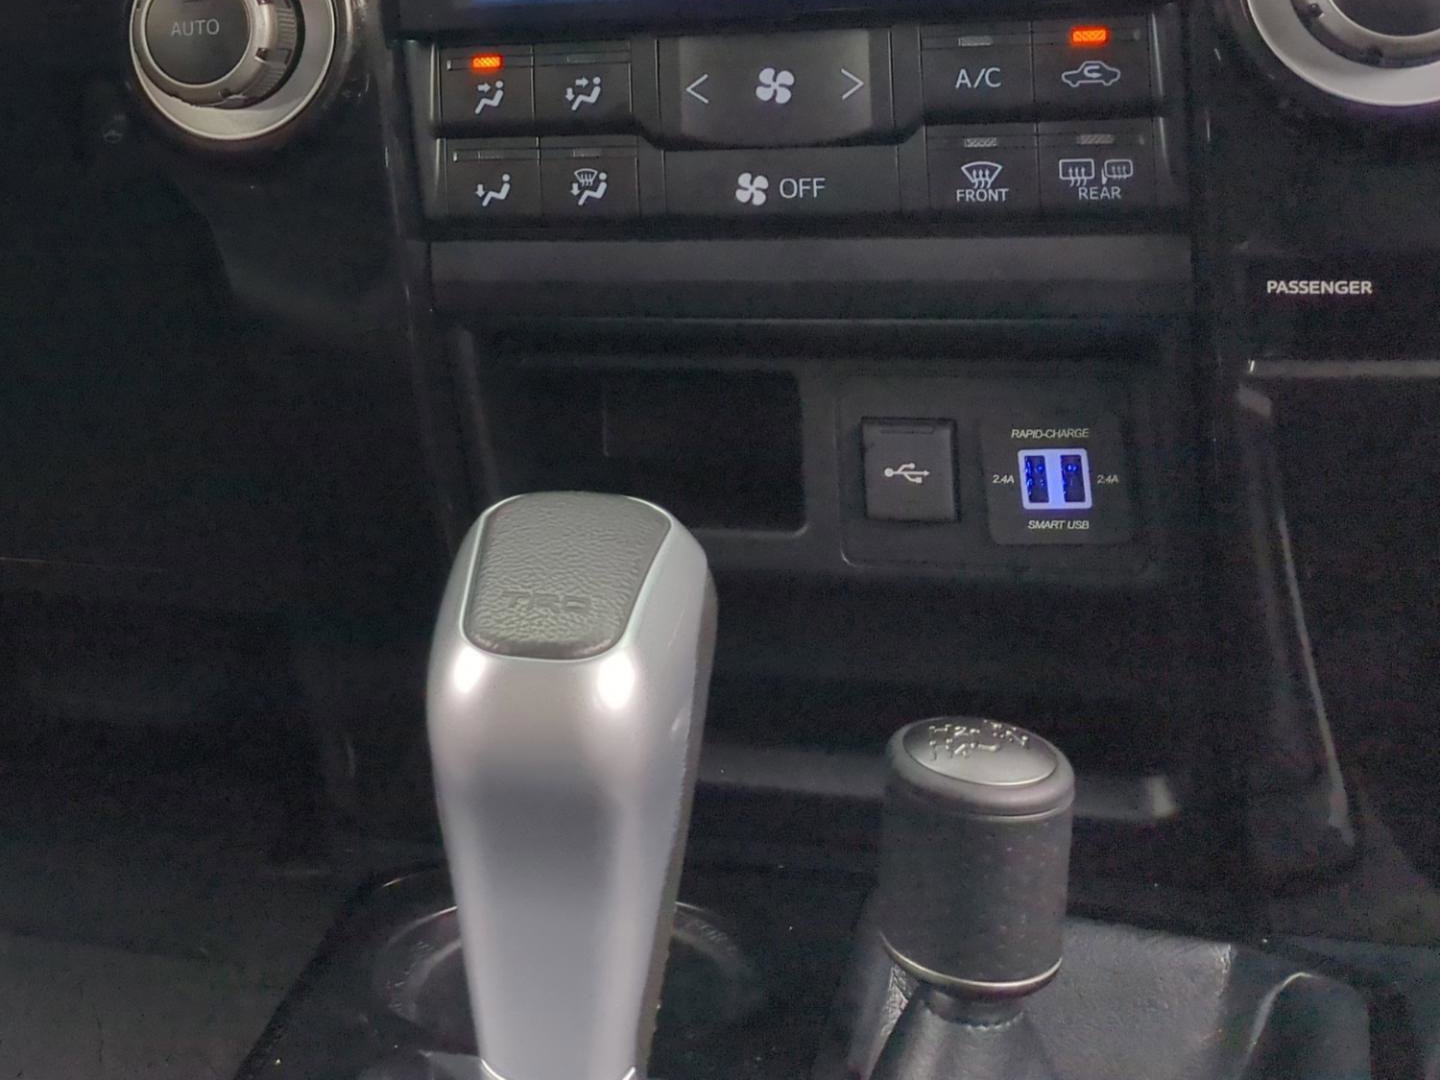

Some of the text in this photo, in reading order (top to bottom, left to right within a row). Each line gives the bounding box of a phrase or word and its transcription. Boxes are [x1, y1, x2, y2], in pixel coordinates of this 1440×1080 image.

[171, 18, 220, 36] AUTO
[955, 67, 1002, 88] A/C
[779, 177, 826, 199] OFF
[956, 188, 1009, 202] FRONT
[1078, 186, 1122, 200] REAR
[1266, 280, 1373, 294] PASSENGER
[1011, 428, 1089, 439] RAPID-CHARGE
[1028, 520, 1089, 529] SMART USB
